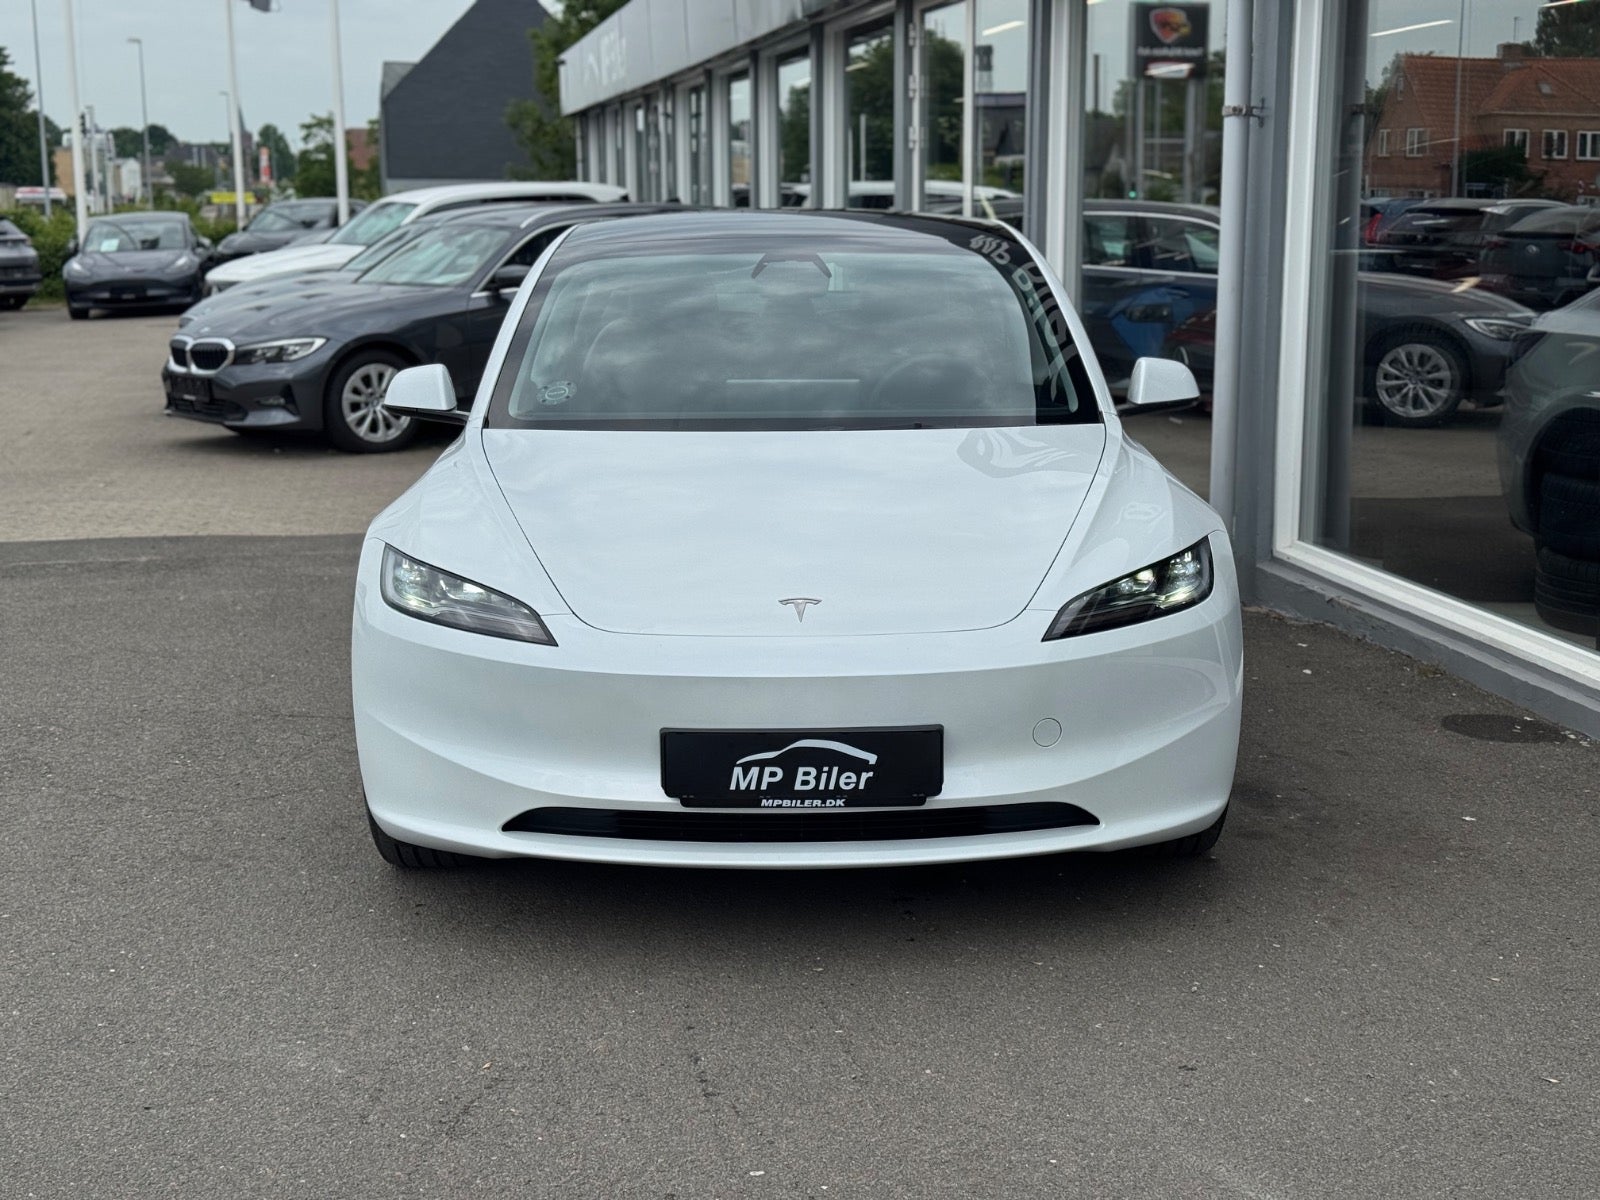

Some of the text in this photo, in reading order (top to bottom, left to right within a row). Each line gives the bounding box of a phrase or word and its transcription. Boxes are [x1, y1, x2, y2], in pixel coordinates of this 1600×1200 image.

[729, 766, 873, 791] MP Biler
[760, 799, 846, 807] MPBILER.DK
